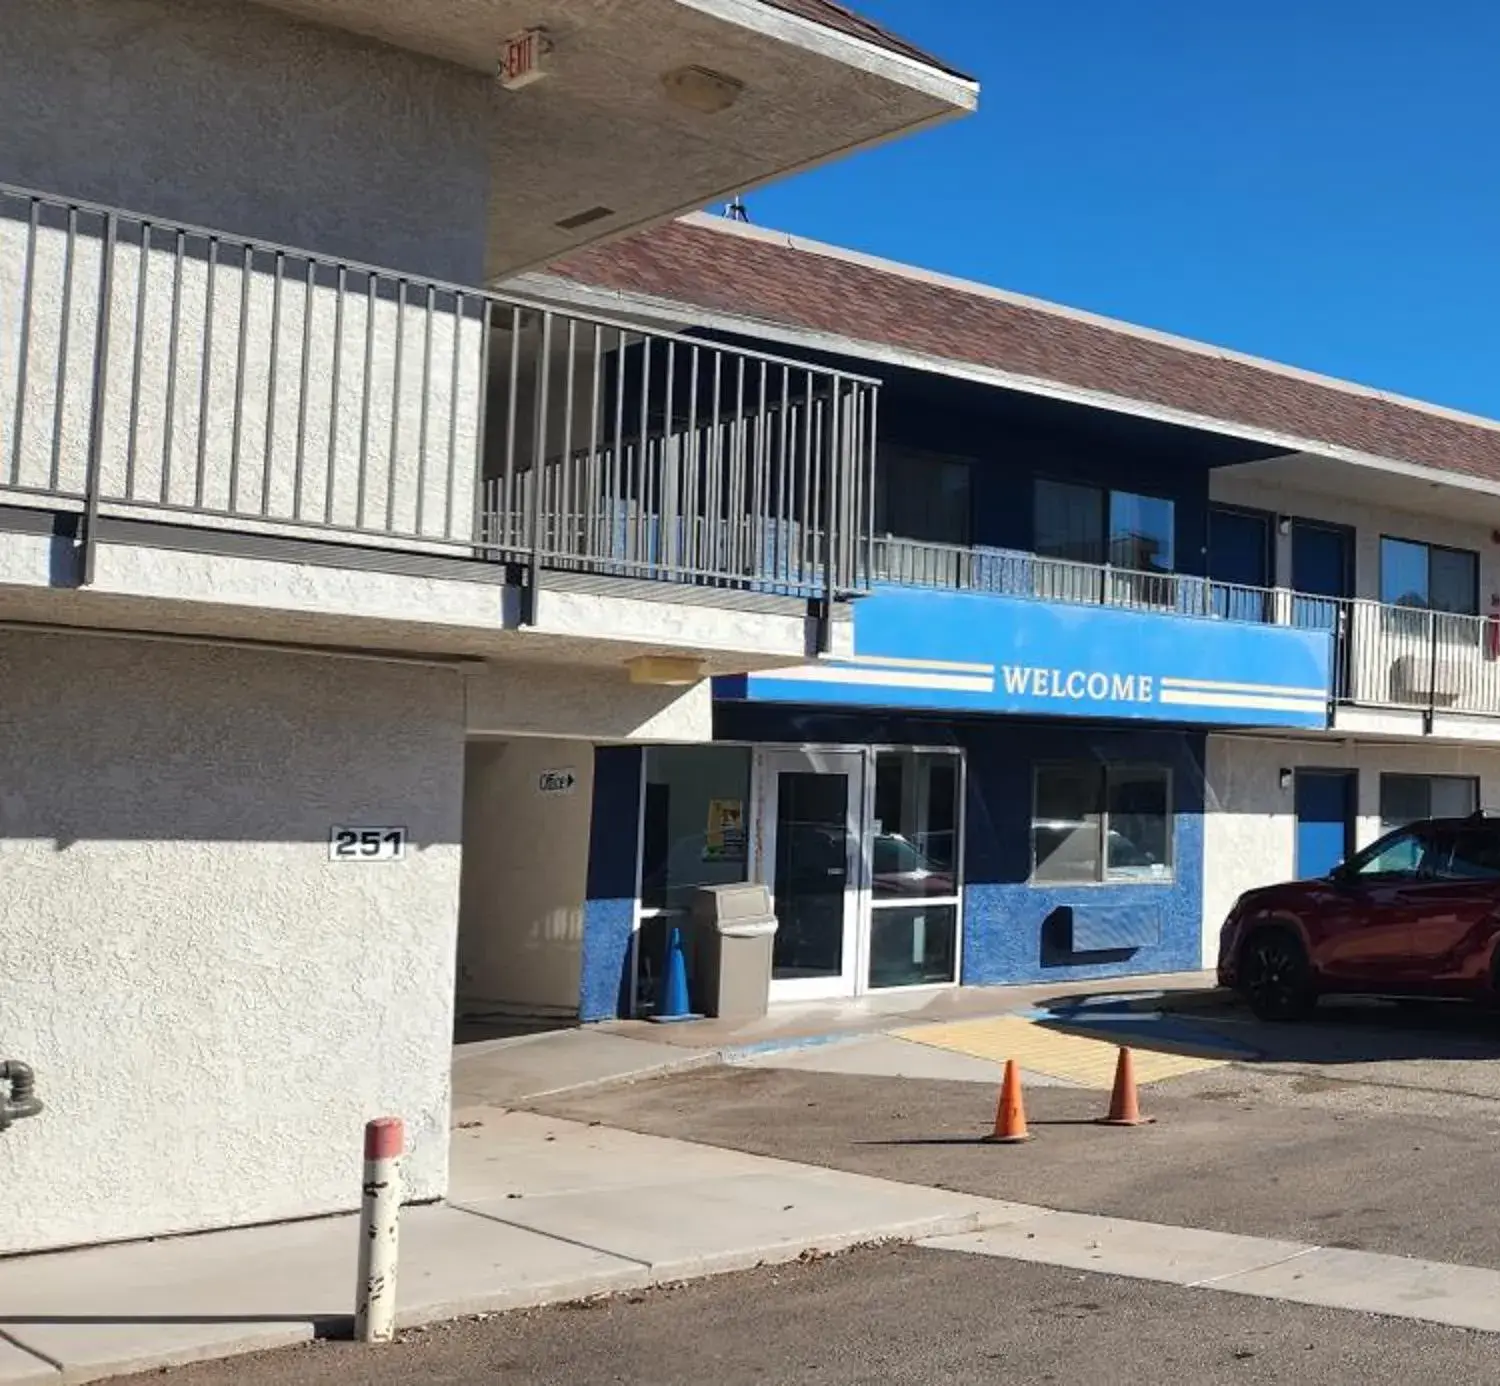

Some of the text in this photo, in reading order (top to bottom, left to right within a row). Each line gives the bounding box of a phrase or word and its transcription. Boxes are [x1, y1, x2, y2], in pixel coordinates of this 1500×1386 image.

[509, 35, 533, 78] EXIT
[1002, 665, 1153, 702] WELCOME
[539, 773, 565, 791] Office
[336, 831, 401, 856] 251
